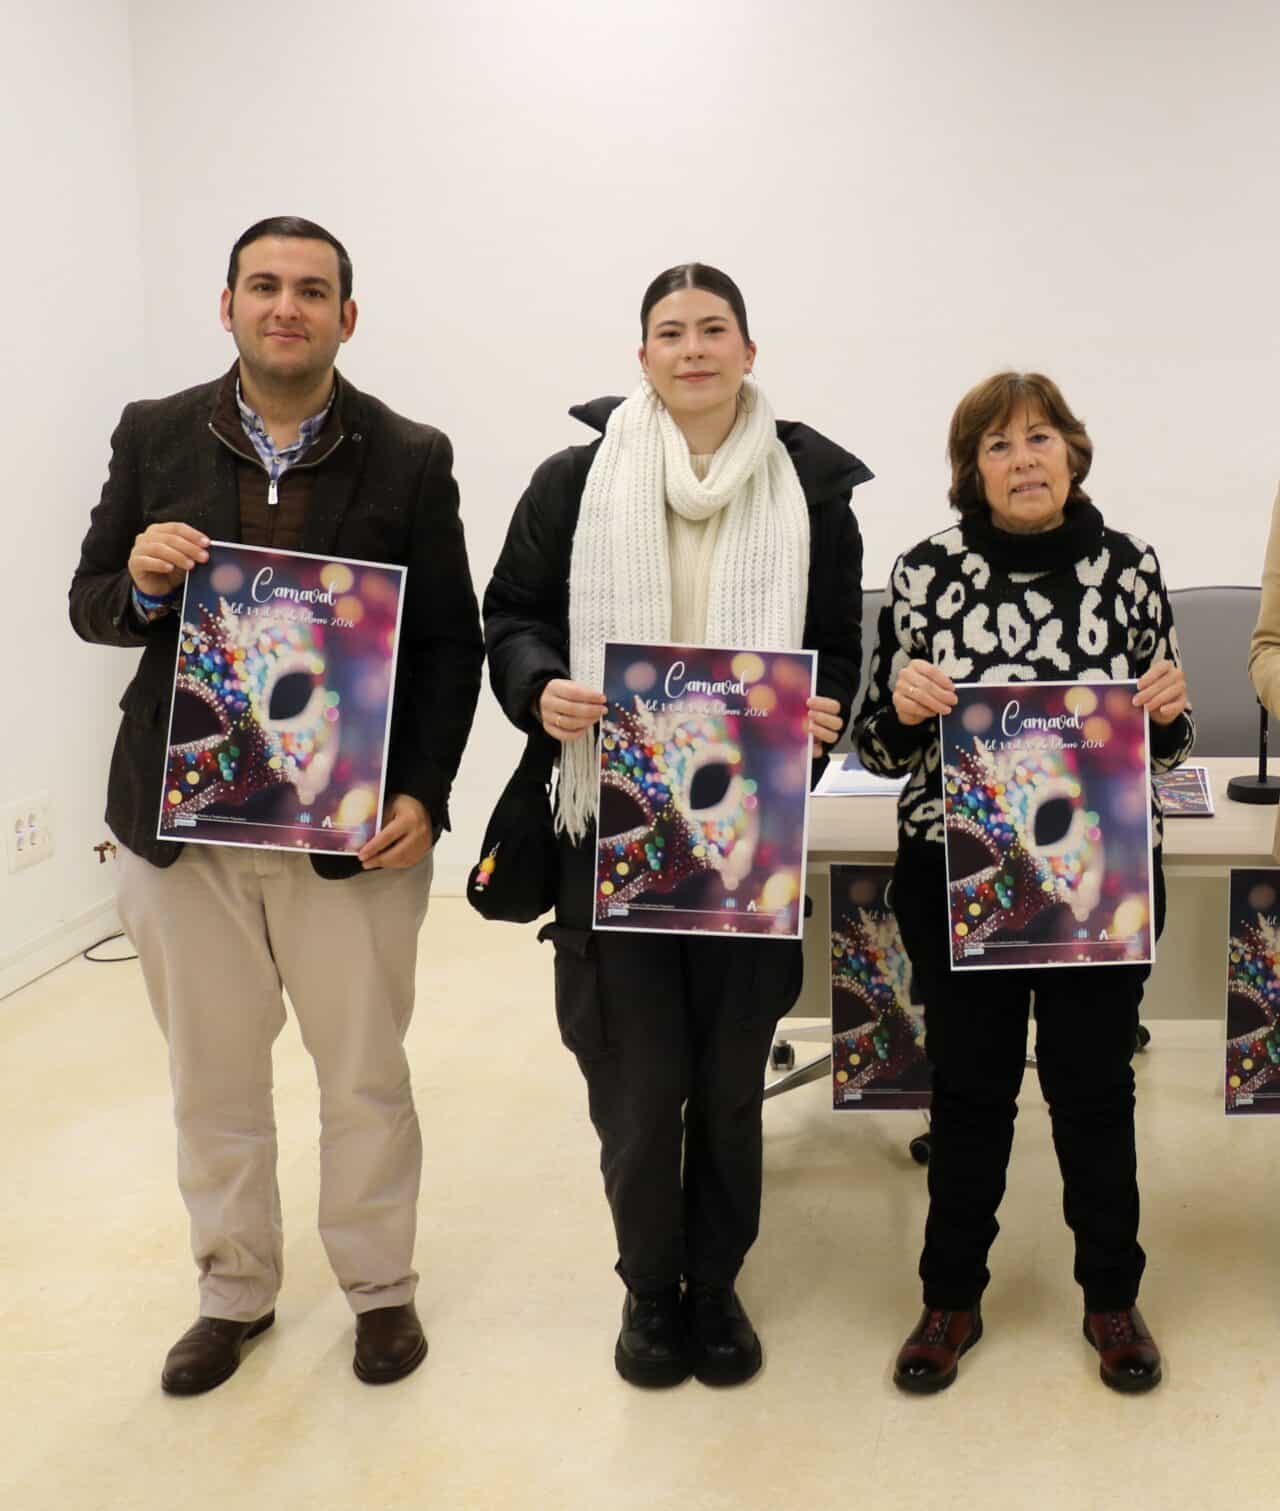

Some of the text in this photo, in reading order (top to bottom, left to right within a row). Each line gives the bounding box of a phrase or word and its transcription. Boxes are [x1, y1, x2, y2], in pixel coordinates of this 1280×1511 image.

[252, 566, 337, 607] Carnaval
[664, 661, 749, 698] Carnaval
[1001, 700, 1084, 736] Carnaval
